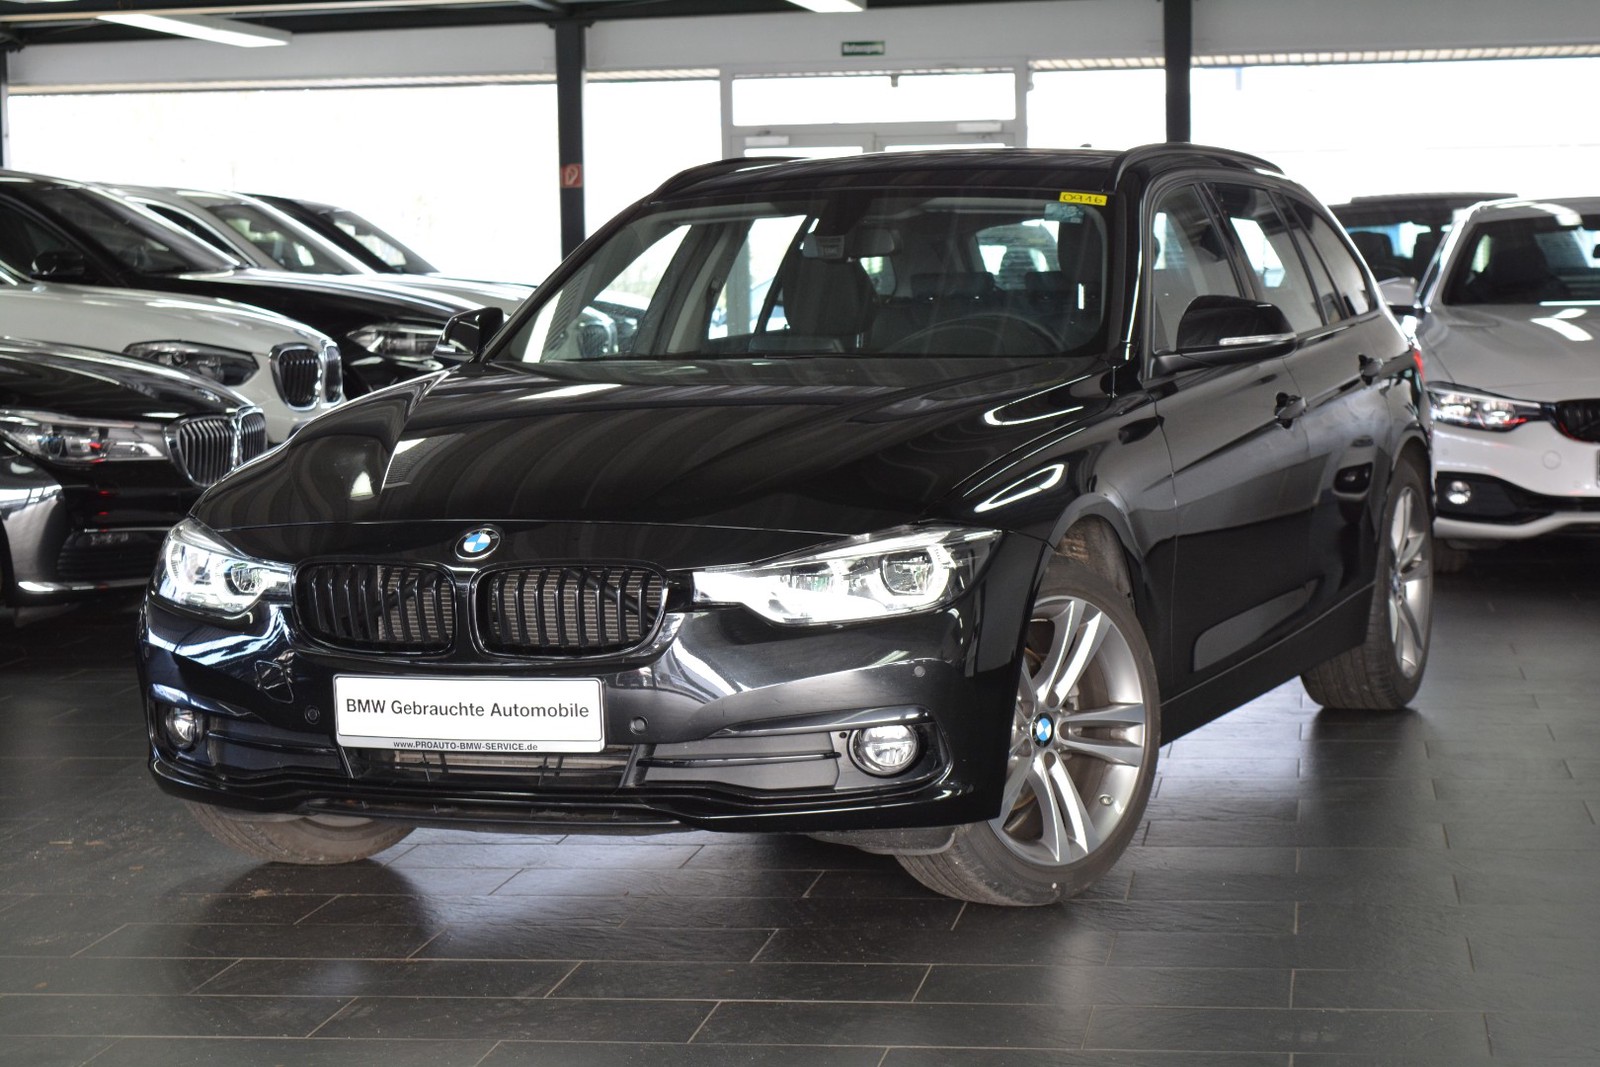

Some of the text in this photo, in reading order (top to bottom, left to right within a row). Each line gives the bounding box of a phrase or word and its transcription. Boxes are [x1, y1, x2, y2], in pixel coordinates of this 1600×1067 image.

[346, 698, 590, 718] BMW Gebrauchte Automobile
[393, 740, 539, 751] www.PROAUTO-BMW-SERVICE.de
